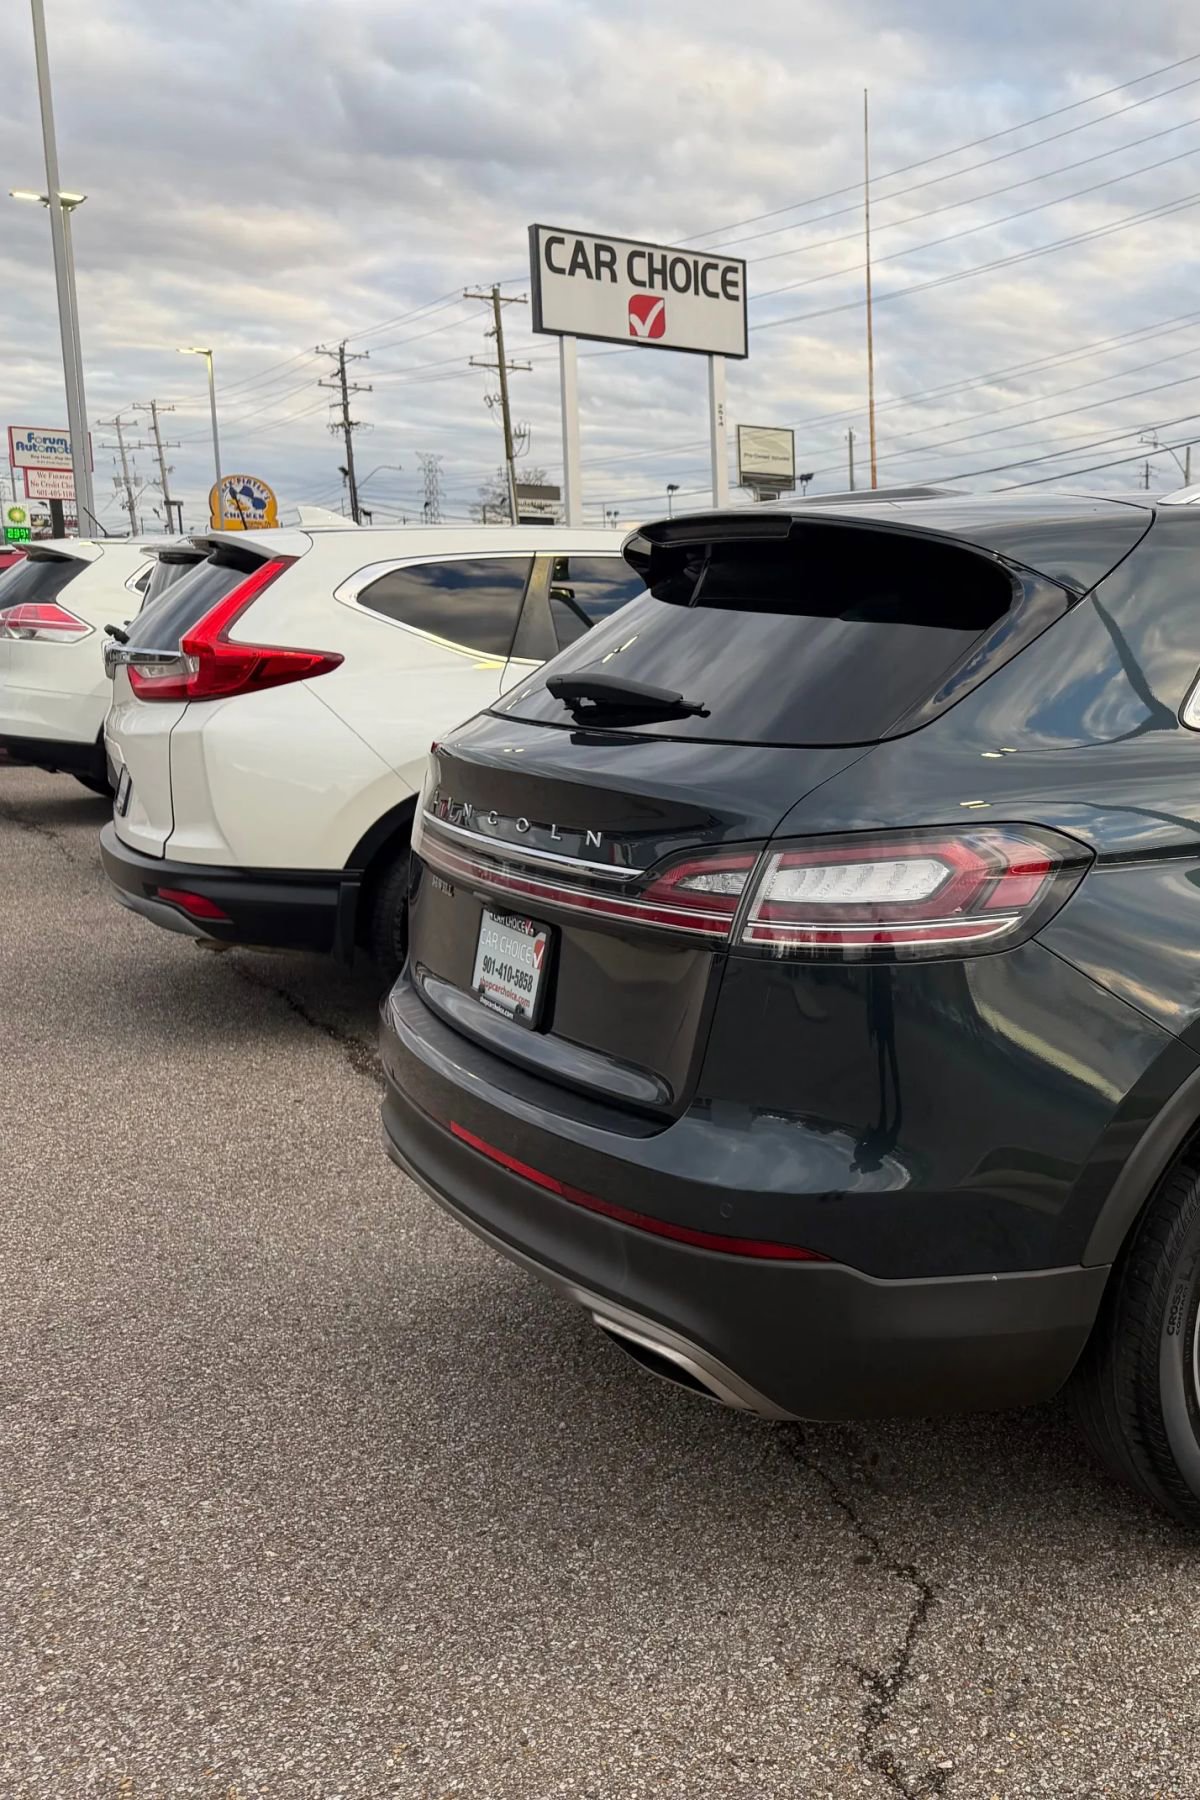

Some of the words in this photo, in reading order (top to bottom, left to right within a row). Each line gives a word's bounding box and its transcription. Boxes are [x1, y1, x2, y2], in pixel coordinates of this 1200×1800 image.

[544, 236, 618, 283] CAR
[627, 250, 740, 302] CHOICE
[27, 432, 67, 445] Forum
[433, 791, 603, 848] LINCOLN
[480, 928, 498, 949] CAR
[499, 936, 532, 964] CHOICE
[482, 955, 533, 993] 901-410-5858
